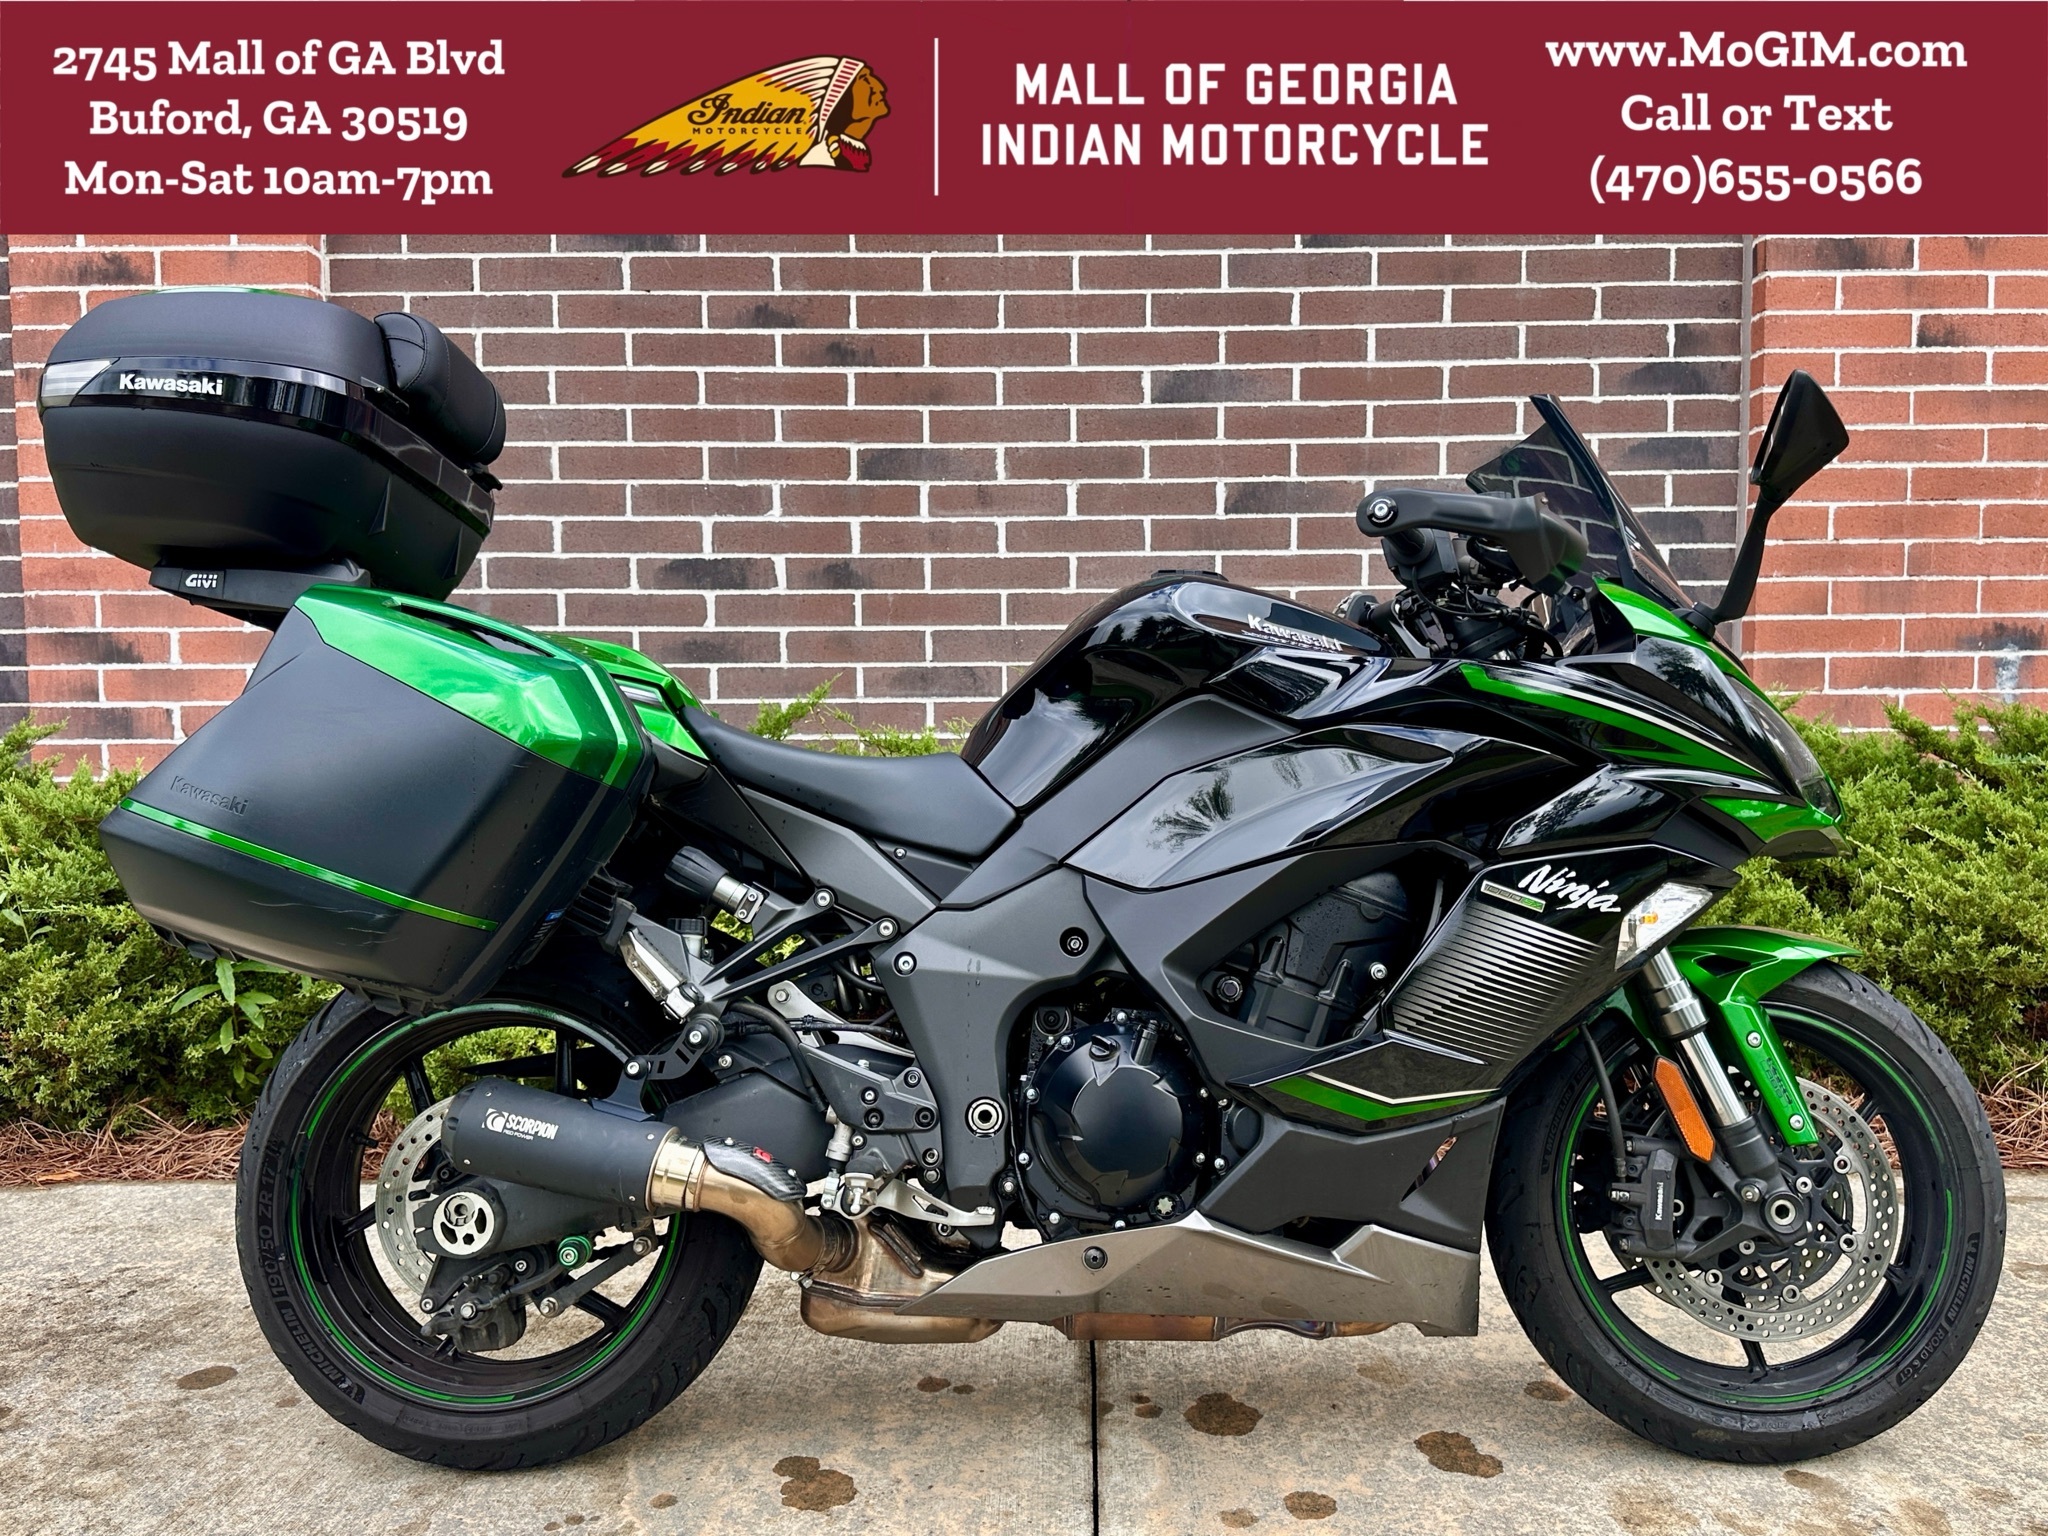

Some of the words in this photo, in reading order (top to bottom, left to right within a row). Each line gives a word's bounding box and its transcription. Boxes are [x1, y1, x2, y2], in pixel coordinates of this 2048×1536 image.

[119, 373, 223, 396] Kawasaki
[1247, 613, 1343, 652] Kawasaki
[170, 775, 249, 817] Kawasaki
[1518, 864, 1622, 912] Ninja
[506, 1114, 559, 1140] SCORPION
[259, 1189, 273, 1215] ZR
[1947, 1255, 1976, 1322] MICHELIN
[281, 1307, 342, 1384] MICHELIN
[1920, 1327, 1944, 1360] ROAD
[1900, 1367, 1914, 1382] GT
